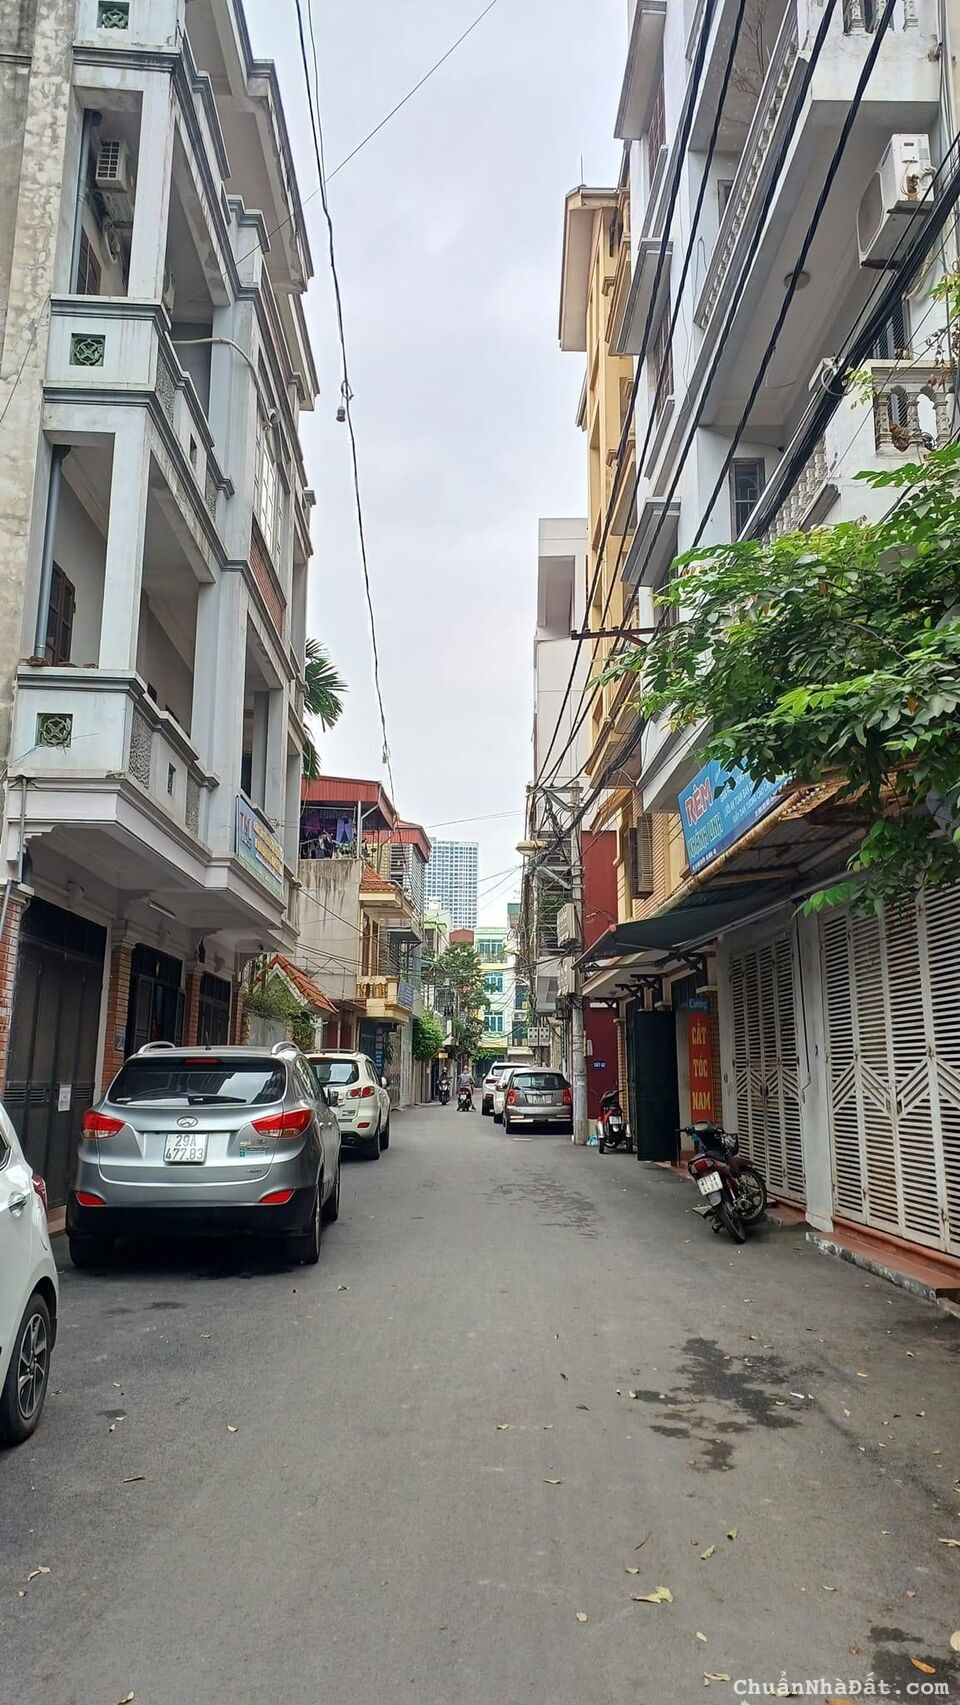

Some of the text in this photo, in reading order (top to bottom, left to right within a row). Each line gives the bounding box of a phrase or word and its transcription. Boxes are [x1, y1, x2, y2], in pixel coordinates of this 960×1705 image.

[693, 1054, 708, 1078] TÓC
[692, 1091, 711, 1110] NAM
[175, 1135, 197, 1147] 29A
[165, 1147, 204, 1161] 477.83
